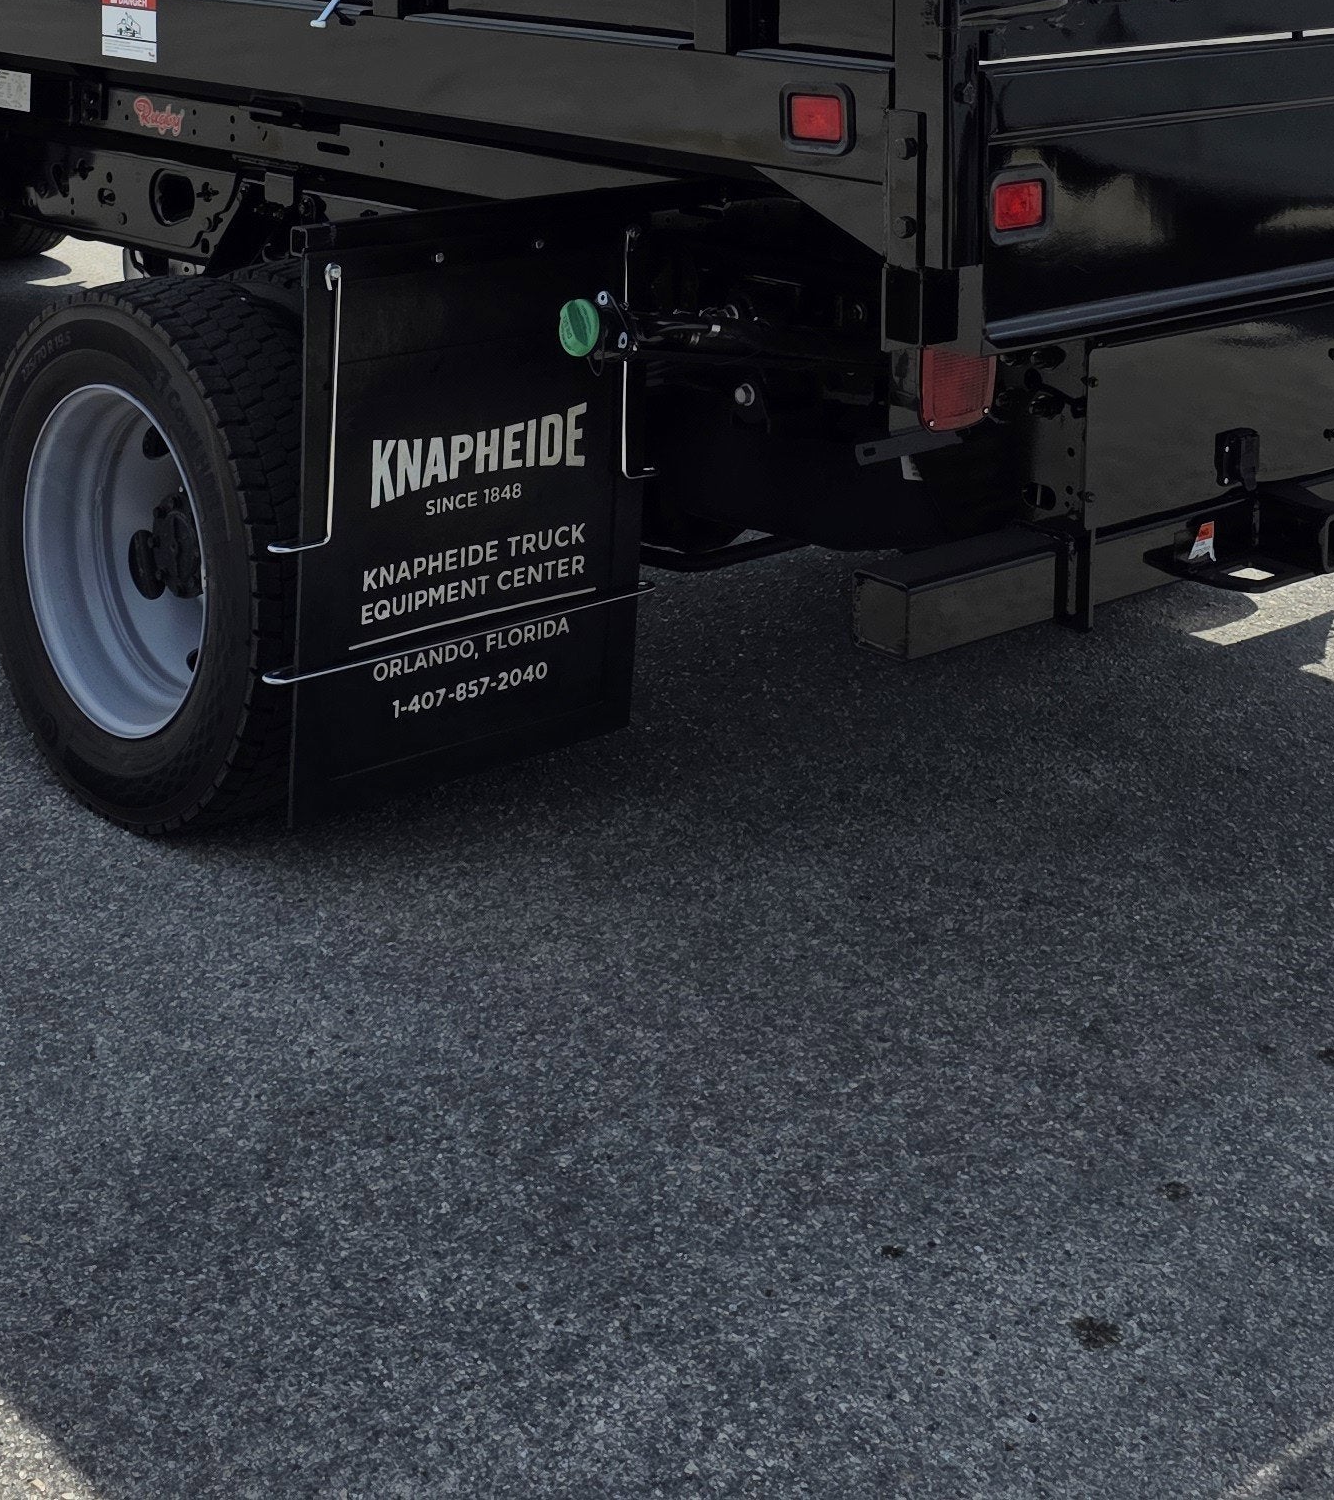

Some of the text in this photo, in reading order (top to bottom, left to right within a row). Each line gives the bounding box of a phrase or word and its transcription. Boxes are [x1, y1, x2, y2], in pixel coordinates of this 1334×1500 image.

[135, 96, 185, 137] Rugby
[370, 401, 588, 510] KNAPHEIDE
[425, 481, 523, 517] SINCE 1848
[360, 554, 585, 626] EQUIPMENT CENTER
[362, 522, 586, 593] KNAPHEIDE TRUCK
[372, 616, 570, 682] ORLANDO, FLORIDA
[391, 660, 549, 719] 1-407-857-2040
